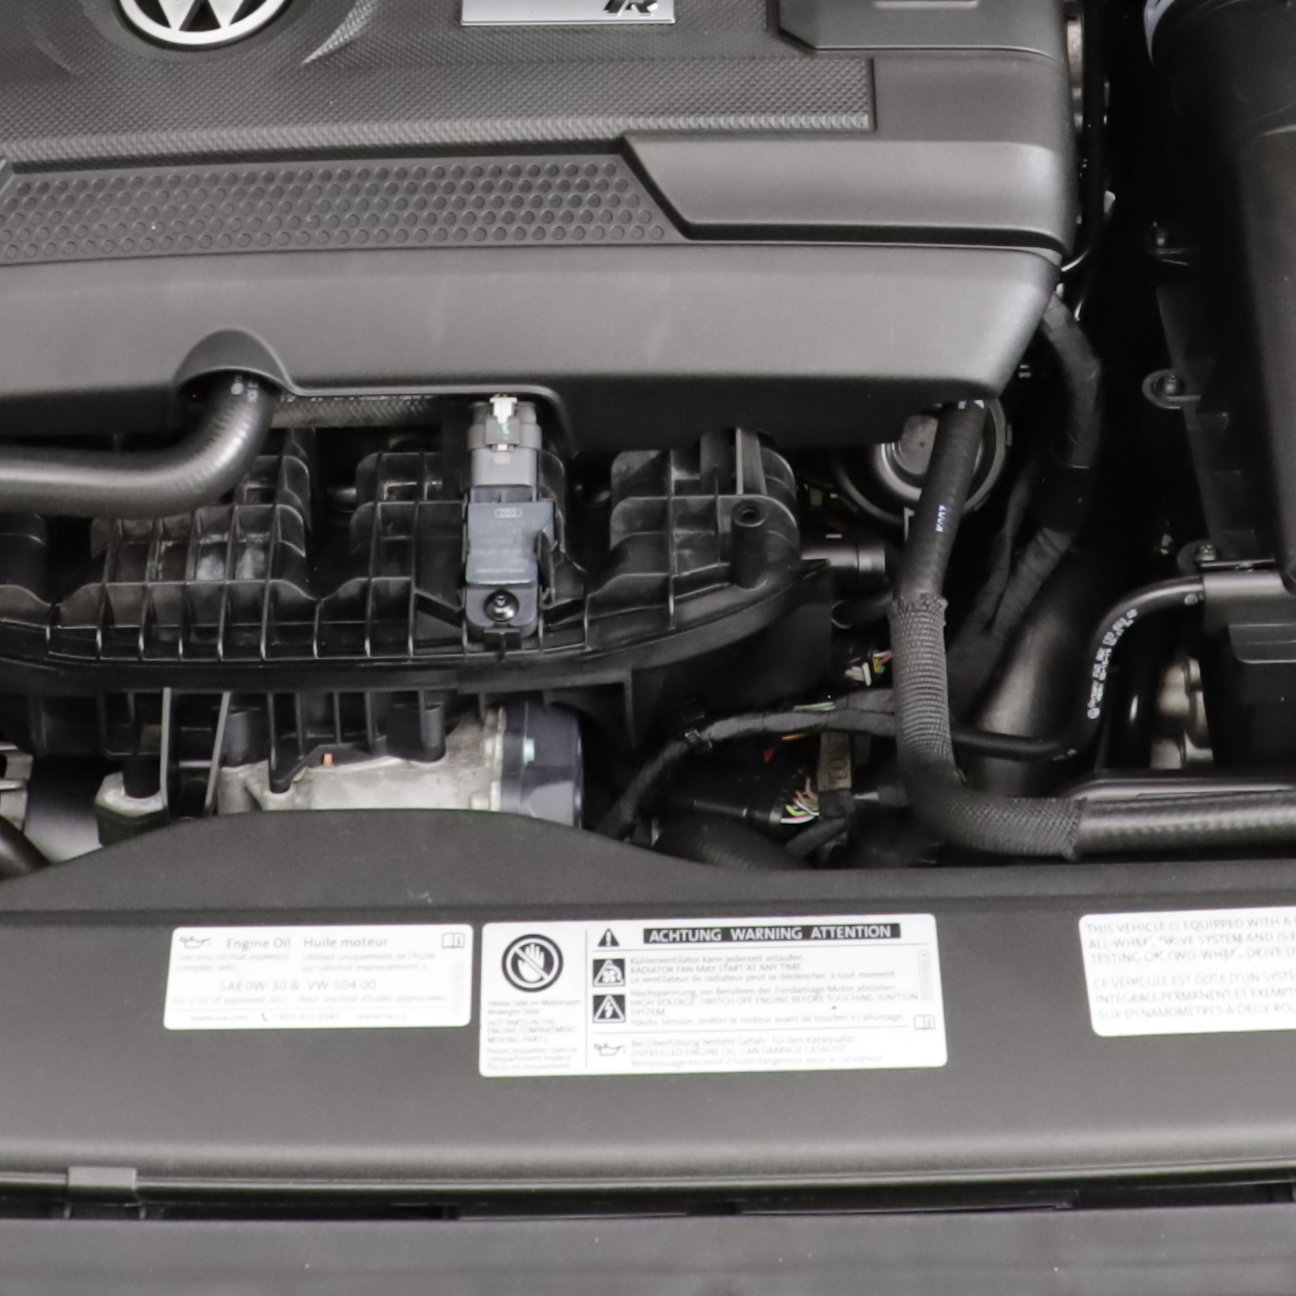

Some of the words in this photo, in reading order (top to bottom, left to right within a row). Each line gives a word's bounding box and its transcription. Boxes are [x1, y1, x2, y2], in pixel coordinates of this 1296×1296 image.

[1086, 922, 1114, 934] THIS
[1117, 921, 1166, 933] VEHICLE
[1169, 920, 1181, 931] IS
[1183, 918, 1245, 931] EQUIPPED
[1247, 916, 1280, 928] WITH
[1283, 916, 1292, 926] A
[649, 928, 722, 943] ACHTUNG
[731, 926, 803, 941] WARNING
[810, 925, 891, 940] ATTENTION
[1198, 932, 1244, 945] SYSTEM
[1247, 931, 1273, 943] AND
[1277, 931, 1289, 942] IS
[226, 937, 269, 952] Engine
[273, 937, 291, 948] Oil
[304, 936, 336, 948] Huile
[340, 938, 388, 948] moteur
[1091, 951, 1142, 964] TESTING
[1246, 946, 1281, 958] DRIVE
[630, 965, 674, 974] RADIATOR
[677, 965, 694, 973] FAN
[696, 964, 716, 973] MAY
[747, 963, 757, 972] AT
[759, 962, 777, 971] ANY
[307, 979, 329, 990] VW
[333, 979, 357, 990] 504
[359, 979, 377, 990] 00
[1160, 988, 1231, 1001] PERMANENT
[1234, 987, 1247, 999] ET
[1098, 1007, 1122, 1020] SUR
